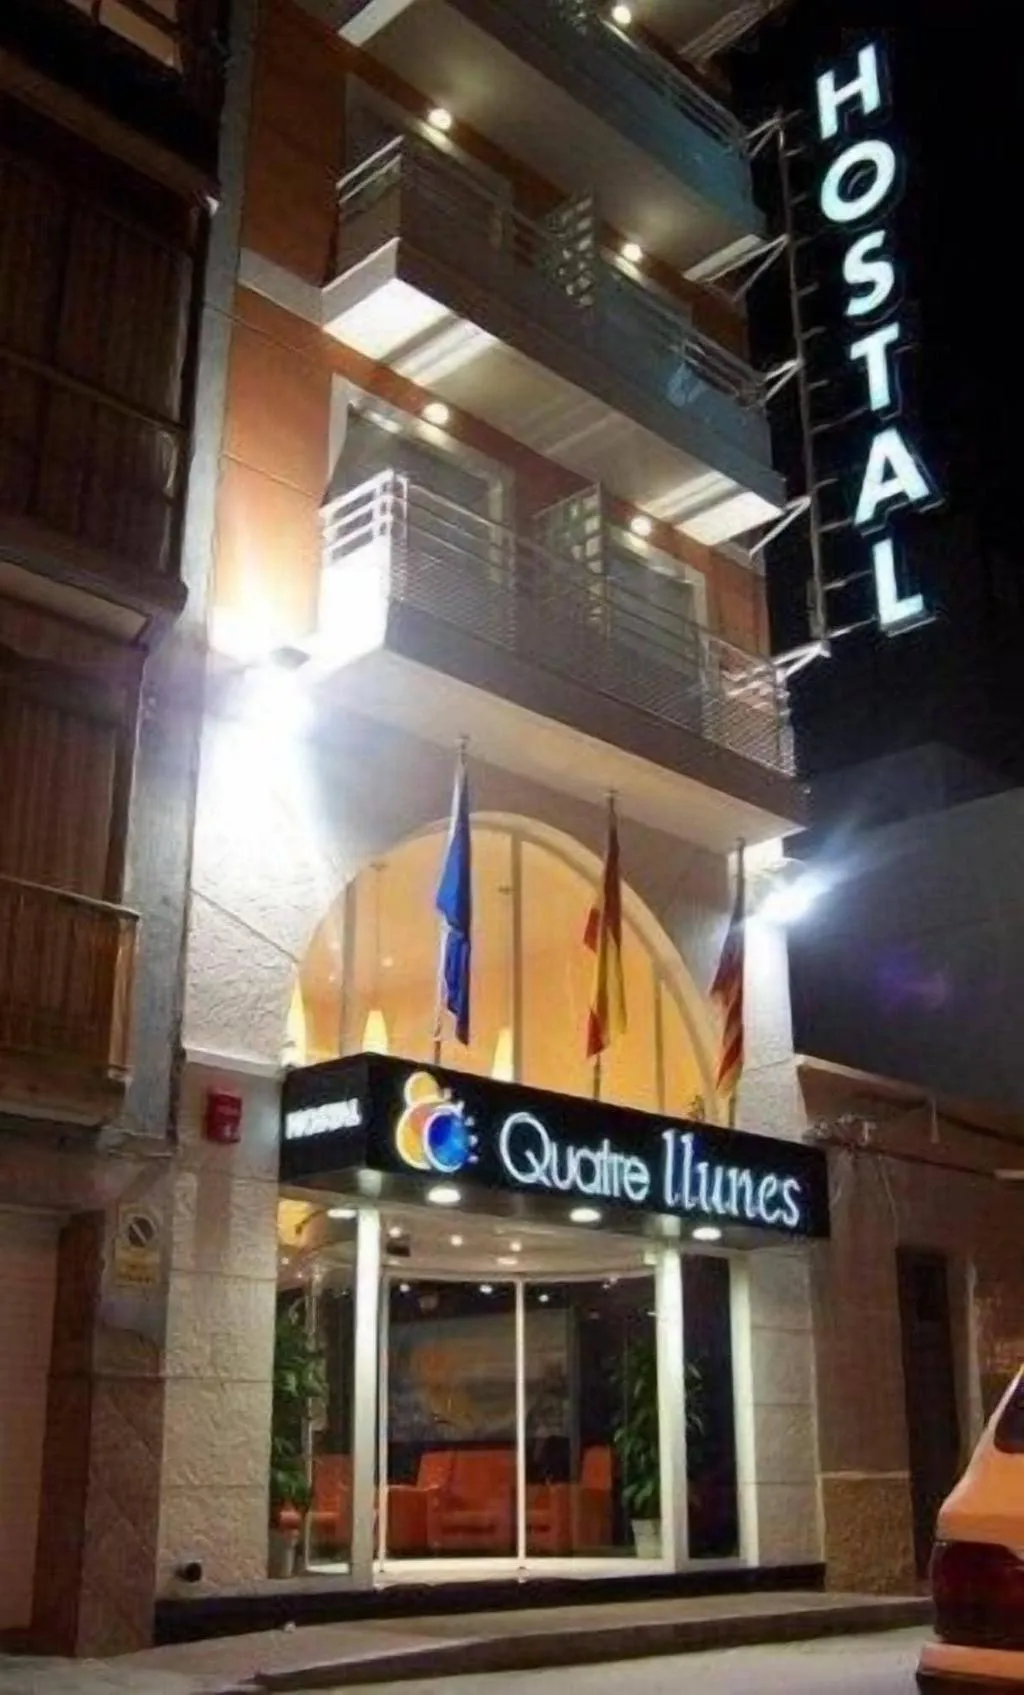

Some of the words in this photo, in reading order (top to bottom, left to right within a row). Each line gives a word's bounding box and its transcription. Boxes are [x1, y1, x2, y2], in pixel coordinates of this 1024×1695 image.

[816, 44, 929, 627] HOSTAL
[499, 1111, 651, 1201] Quatre
[662, 1128, 801, 1227] llunes
